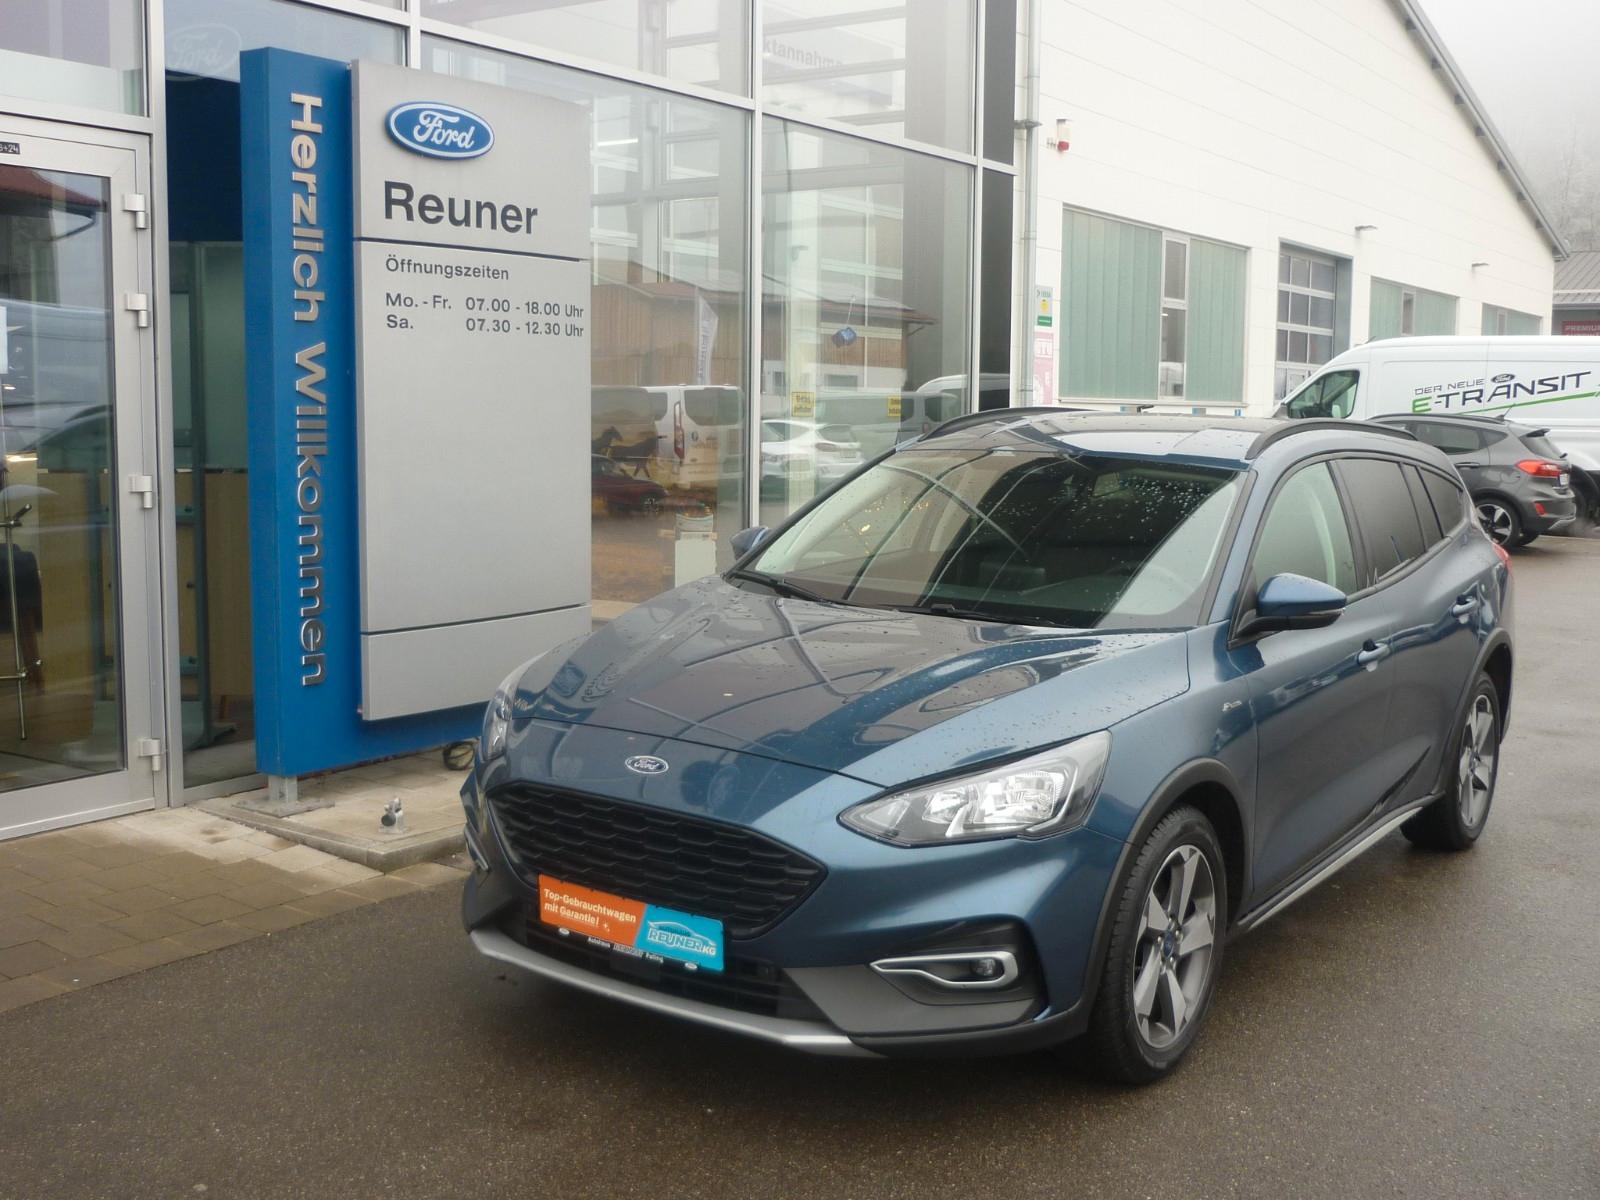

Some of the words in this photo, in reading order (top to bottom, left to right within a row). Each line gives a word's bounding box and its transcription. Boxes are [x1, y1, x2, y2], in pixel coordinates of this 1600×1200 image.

[413, 110, 475, 149] Ford
[291, 92, 325, 322] Herzlich
[384, 180, 538, 234] Reuner
[385, 254, 509, 280] Öffnungszeiten
[385, 292, 418, 308] Mo.
[432, 295, 451, 310] Fr.
[465, 297, 510, 313] 07.00
[525, 301, 560, 316] 18.00
[565, 304, 584, 318] Uhr
[386, 314, 413, 329] Sa.
[465, 318, 510, 333] 07.30
[525, 322, 560, 336] 12.30
[565, 324, 584, 337] Uhr
[1412, 371, 1591, 413] E-TRANSIT
[1414, 385, 1442, 395] DER
[1447, 378, 1485, 390] NEUE
[295, 341, 327, 686] Willkommen
[543, 888, 637, 923] Top-Gebrauchtwagen
[544, 902, 558, 914] mit
[559, 906, 600, 927] Garantie!
[702, 944, 717, 956] KG
